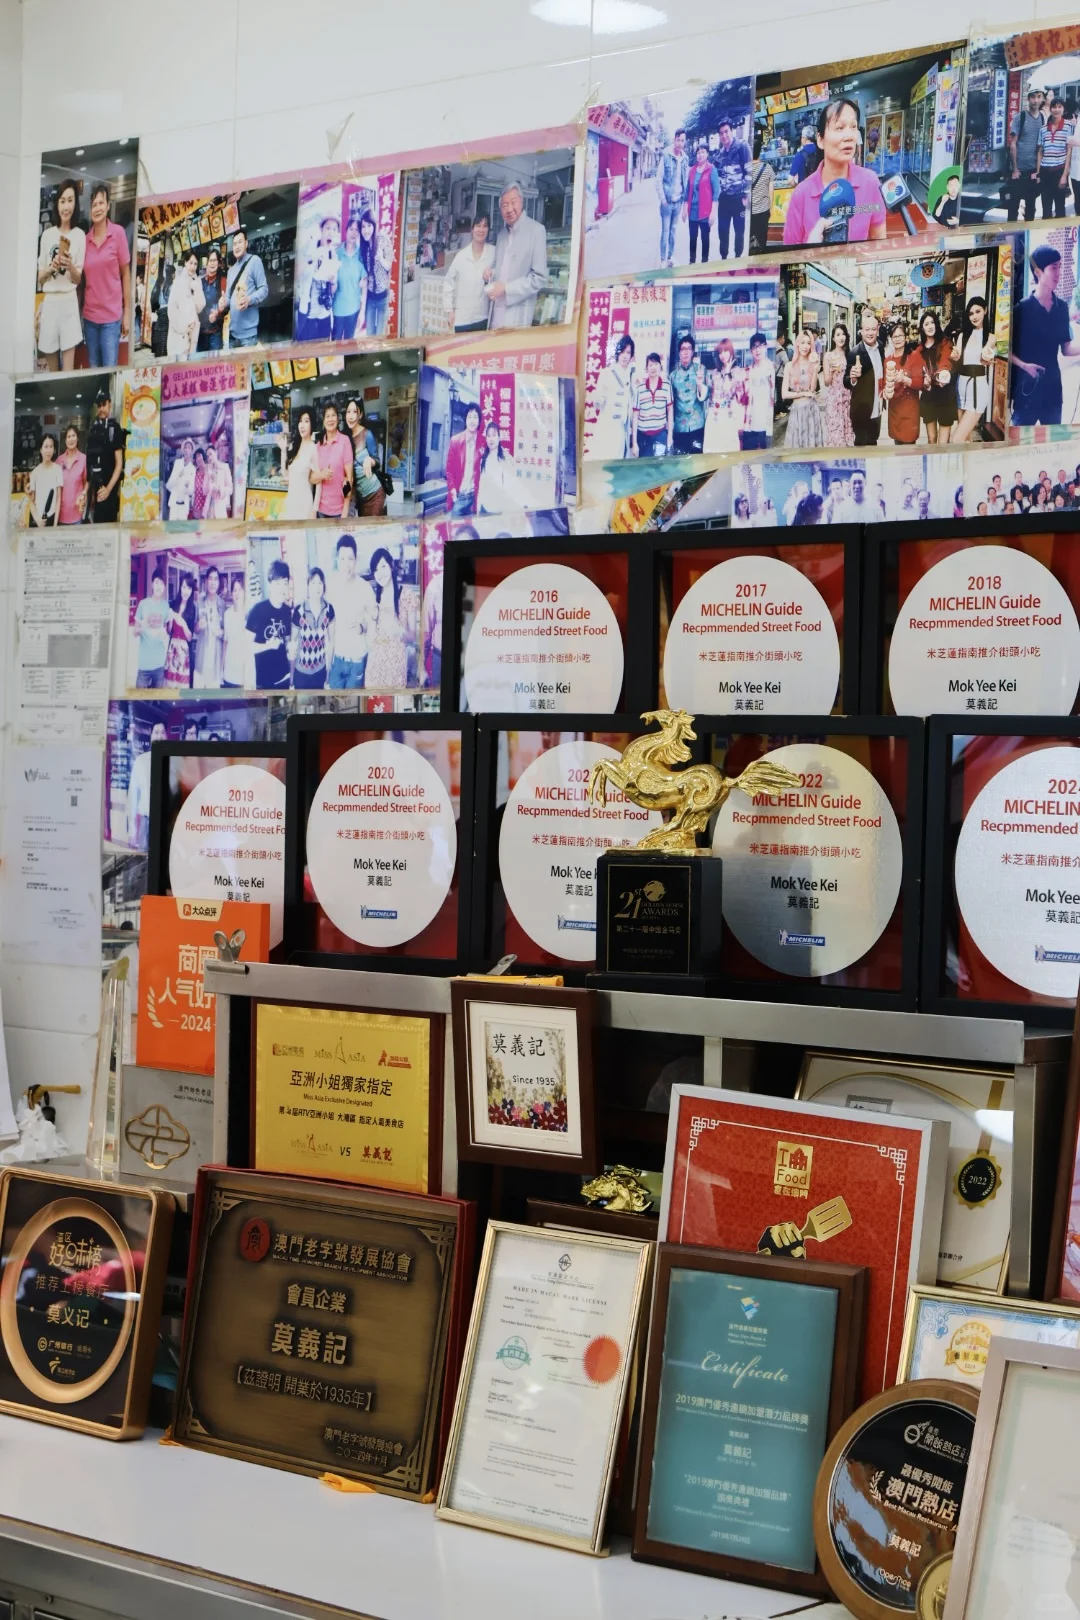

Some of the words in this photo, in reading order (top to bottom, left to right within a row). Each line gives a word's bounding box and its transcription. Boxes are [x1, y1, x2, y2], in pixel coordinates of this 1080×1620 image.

[967, 575, 1002, 590] 2018
[530, 590, 559, 603] 2016
[735, 584, 767, 598] 2017
[701, 602, 762, 616] MICHELIN
[765, 602, 803, 616] Guide
[929, 596, 996, 611] MICHELIN
[999, 594, 1041, 609] Guide
[498, 607, 554, 621] MICHELIN
[556, 607, 591, 620] Guide
[553, 625, 582, 636] Street
[583, 624, 608, 635] Food
[682, 622, 760, 635] Recpmmended
[762, 621, 792, 632] Street
[795, 621, 822, 632] Food
[909, 616, 994, 631] Recpmmended
[996, 615, 1030, 627] Street
[1032, 614, 1062, 626] Food
[497, 653, 591, 664] 米芝蓮指南推介街頭小吃
[699, 651, 802, 662] 米芝蓮指南推介街頭小吃
[927, 646, 1041, 659] 米芝蓮指南推介街頭小吃
[514, 682, 536, 694] Mok
[537, 682, 554, 694] Yee
[556, 682, 571, 694] Kei
[718, 681, 742, 694] Mok
[743, 681, 762, 693] Yee
[764, 680, 781, 694] Kei
[948, 679, 974, 692] Mok
[976, 679, 996, 692] Yee
[999, 679, 1017, 692] Kei
[529, 699, 556, 710] 莫義記
[734, 699, 764, 711] 莫義記
[966, 698, 998, 710] 莫義記
[367, 766, 395, 780] 2020
[567, 768, 590, 783] 202
[794, 773, 823, 788] 022
[338, 784, 390, 797] MICHELIN
[392, 784, 425, 798] Guide
[1048, 779, 1080, 795] 202
[228, 789, 254, 802] 2019
[752, 793, 818, 808] MICHELIN
[820, 794, 862, 809] Guide
[200, 805, 250, 819] MICHELIN
[252, 807, 283, 820] Guide
[322, 801, 389, 814] Recpmmended
[390, 802, 417, 813] Street
[418, 802, 441, 813] Food
[592, 806, 622, 820] Street
[623, 808, 650, 821] Food
[732, 812, 815, 826] Recpmmended
[817, 814, 851, 827] Street
[853, 815, 882, 828] Food
[981, 819, 1078, 835] Recpmmended
[249, 823, 275, 835] Street
[336, 829, 425, 841] 米芝蓮指南推介街頭小吃
[750, 843, 861, 859] 米芝蓮指南推介街頭小吃
[353, 858, 374, 870] Mok
[374, 859, 391, 871] Yee
[392, 859, 407, 871] Kei
[550, 865, 573, 879] Mok
[574, 867, 592, 880] Yee
[213, 875, 233, 887] Mok
[234, 877, 250, 888] Yee
[250, 877, 265, 888] Kei
[367, 875, 392, 887] 莫義記
[770, 876, 796, 890] Mok
[798, 878, 818, 891] Yee
[820, 878, 838, 892] Kei
[564, 884, 594, 897] 莫義記
[1025, 889, 1055, 904] Mok
[1058, 890, 1080, 905] Yee
[787, 896, 820, 910] 莫義記
[191, 906, 217, 917] 大众点评
[642, 908, 679, 916] AWARDS
[180, 1013, 212, 1033] 2024
[492, 1033, 546, 1057] 莫義記
[313, 1048, 333, 1059] MISS
[348, 1052, 366, 1063] ASIA
[289, 1069, 393, 1097] 亞洲小姐獨家指定
[512, 1075, 533, 1085] Since
[536, 1076, 555, 1086] 1935
[303, 1093, 314, 1101] Miss
[314, 1094, 324, 1102] Asia
[324, 1096, 346, 1104] Exclusive
[346, 1098, 373, 1107] Designated
[339, 1146, 351, 1157] VS
[362, 1145, 393, 1161] 莫義記
[777, 1168, 807, 1185] Food
[967, 1175, 987, 1187] 2022
[273, 1233, 412, 1274] 澳門老字號發展協會
[36, 1273, 110, 1299] 推荐上榜餐厅
[287, 1283, 346, 1314] 會員企業
[513, 1285, 529, 1293] MADE
[581, 1298, 608, 1306] LICENSE
[47, 1303, 90, 1329] 莫义记
[271, 1322, 348, 1366] 莫義記
[701, 1350, 789, 1389] Certificate
[323, 1427, 403, 1456] 澳門老字號發展協會
[900, 1462, 954, 1495] 最優秀開飯
[885, 1475, 959, 1523] 澳門熱店
[884, 1500, 897, 1511] Best
[897, 1505, 916, 1518] Macau
[916, 1514, 949, 1531] Restaurant
[888, 1534, 922, 1557] 莫義記
